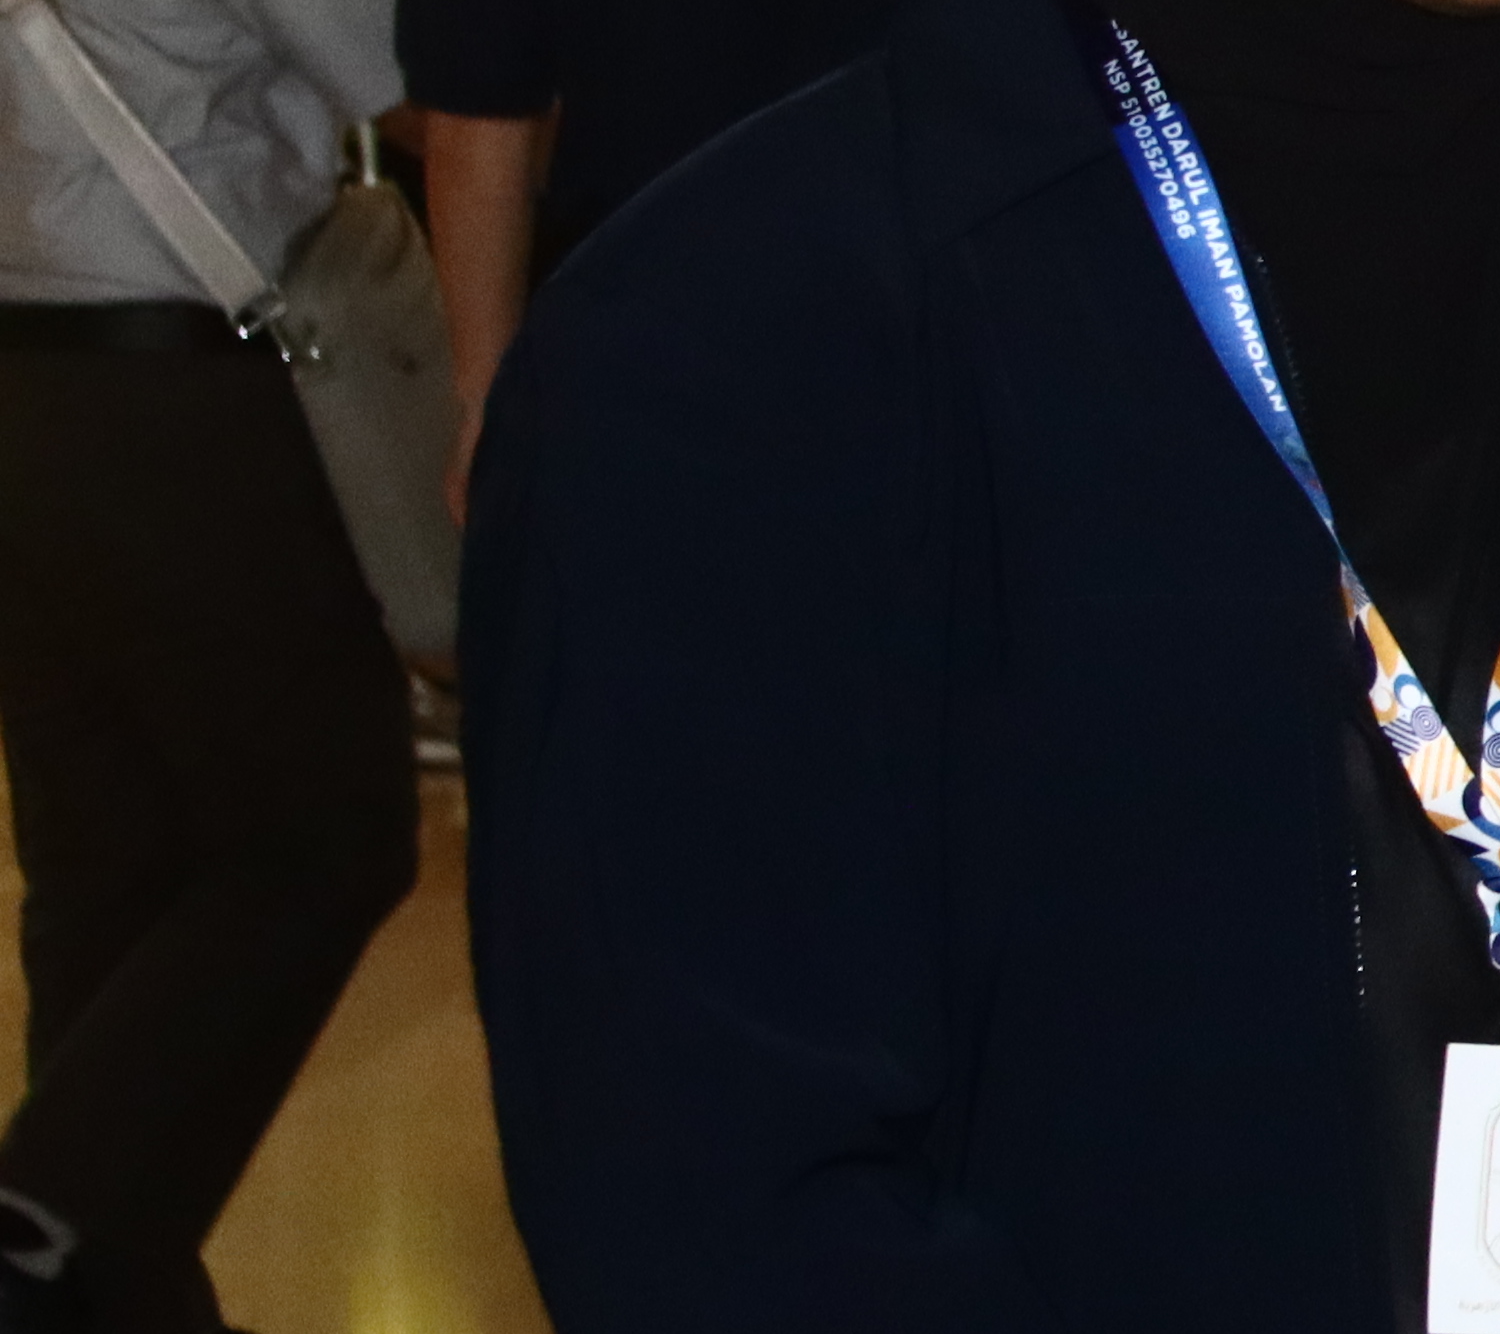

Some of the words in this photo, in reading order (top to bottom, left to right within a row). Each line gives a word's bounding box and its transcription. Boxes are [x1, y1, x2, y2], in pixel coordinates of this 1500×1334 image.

[1104, 58, 1131, 95] NSP
[1121, 97, 1197, 240] 510035270496
[1111, 20, 1176, 122] SANTREN
[1162, 121, 1210, 205] DARUL
[1196, 208, 1238, 279] IMAN
[1225, 284, 1287, 412] PAMOLAN
